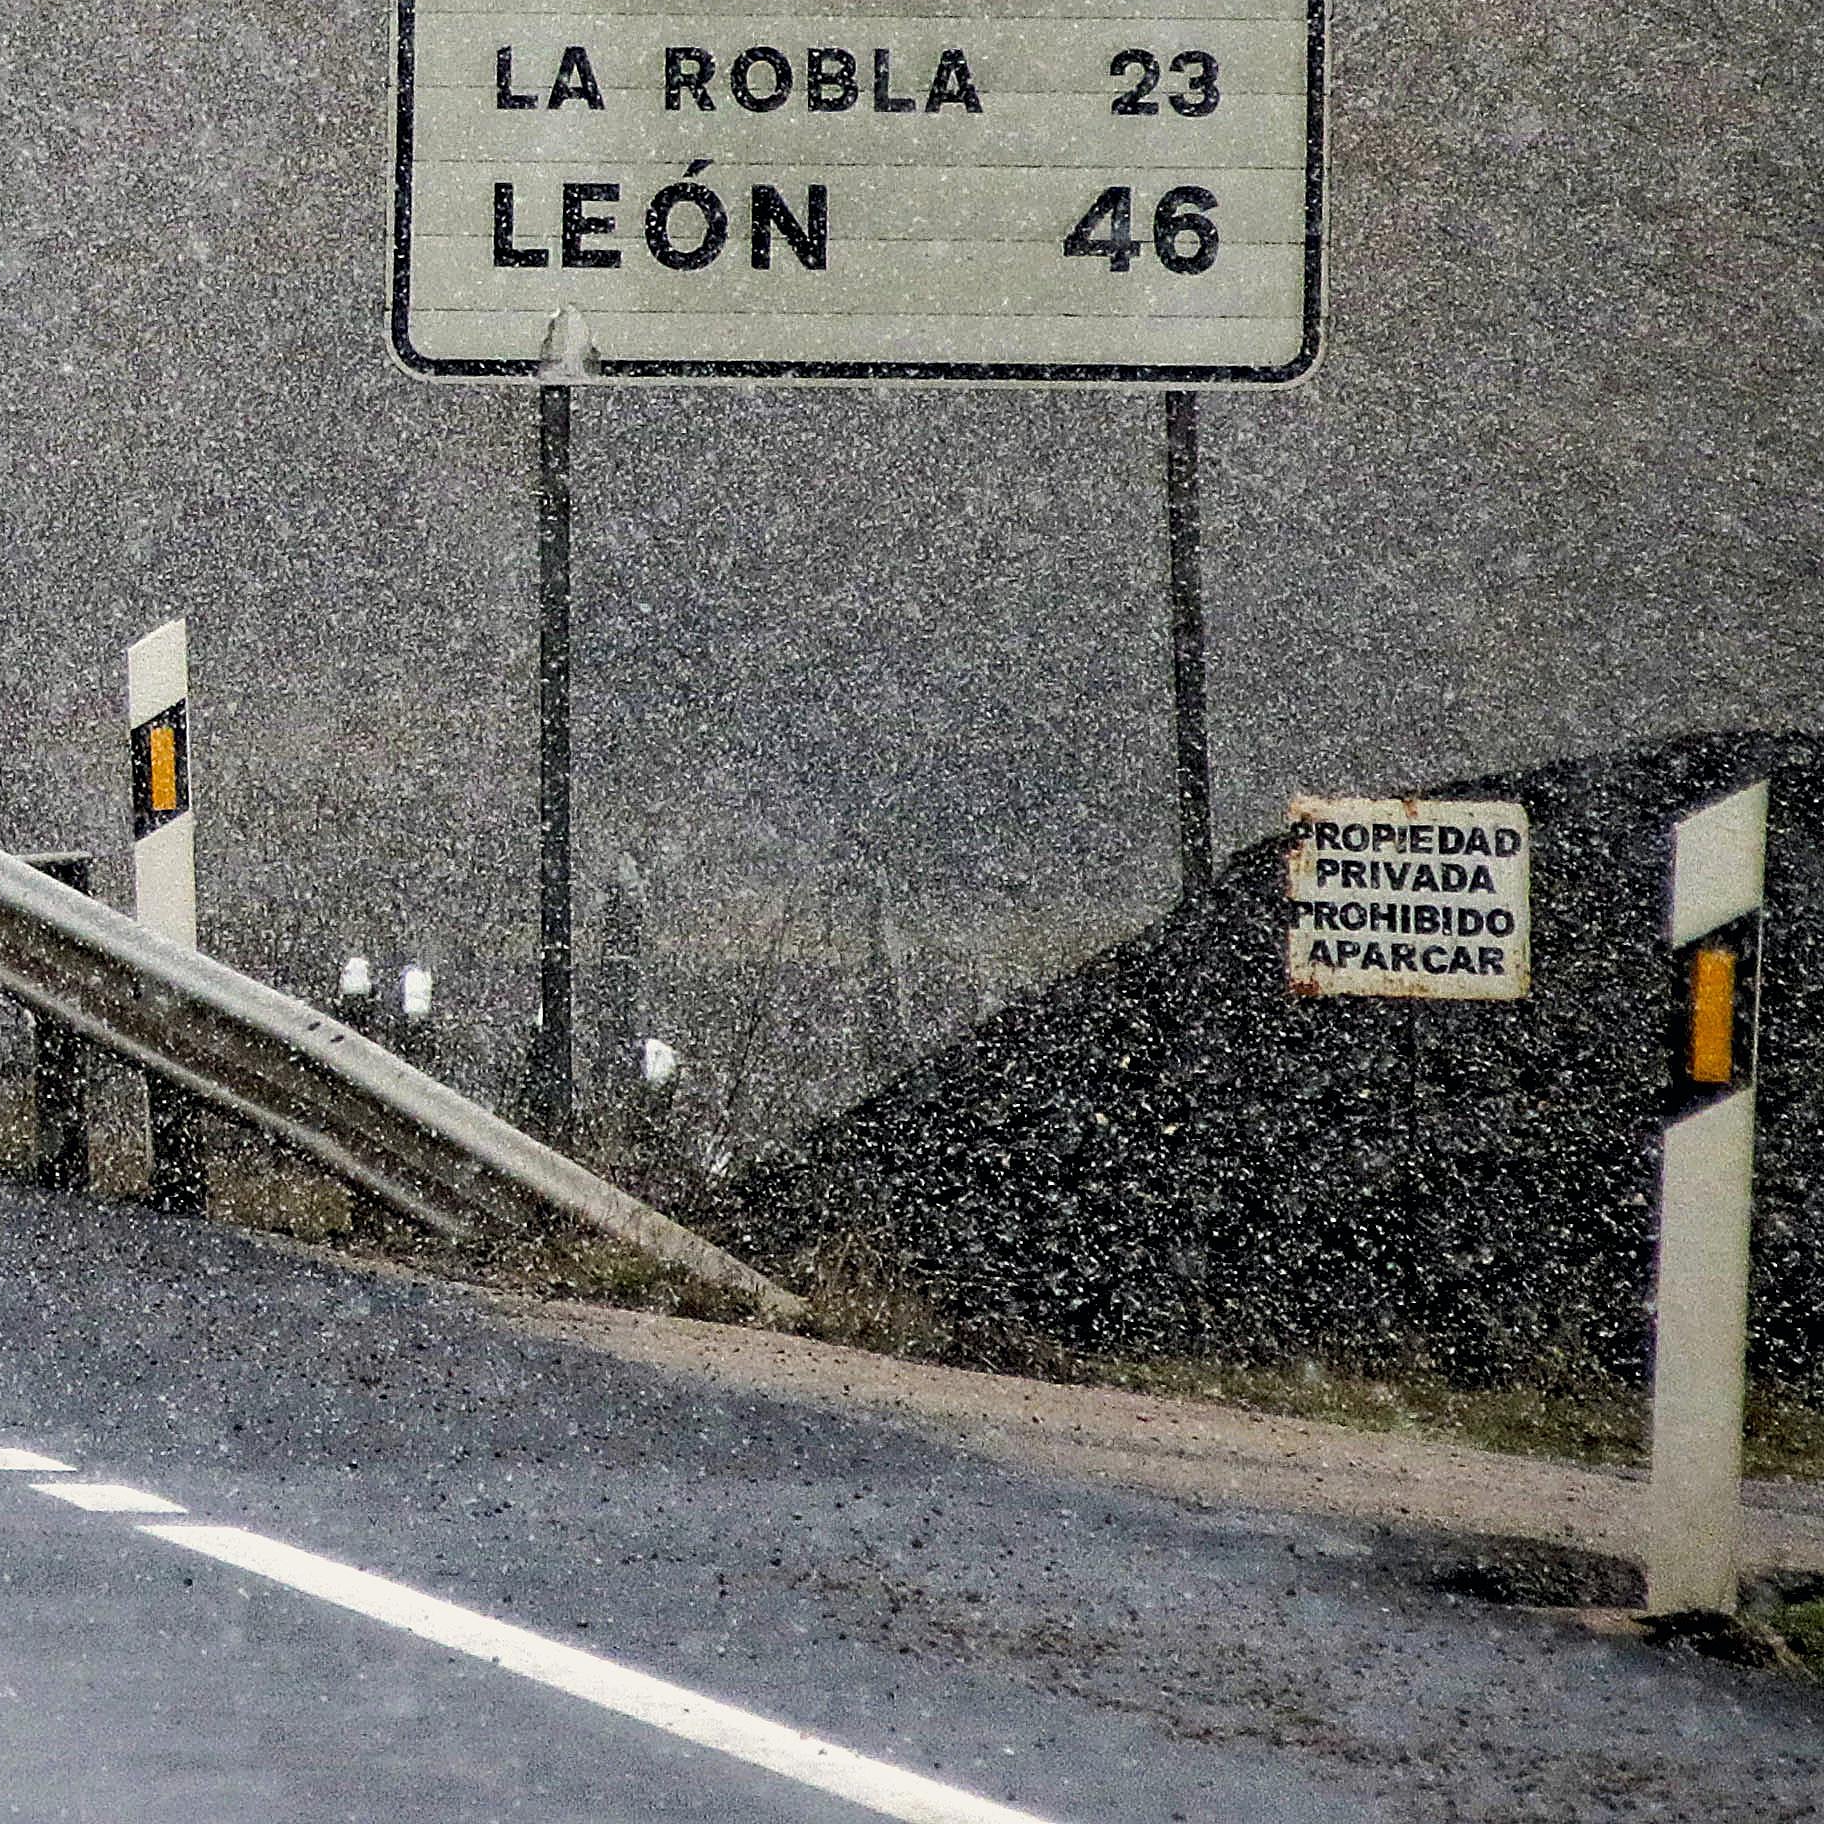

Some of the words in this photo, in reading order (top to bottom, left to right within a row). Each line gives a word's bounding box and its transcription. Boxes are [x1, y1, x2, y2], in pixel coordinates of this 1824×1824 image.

[495, 46, 605, 110] LA
[664, 46, 984, 115] ROBLA
[1108, 48, 1220, 117] 23
[493, 158, 829, 271] LEÓN
[1062, 185, 1220, 274] 46
[1290, 821, 1522, 858] PROPIEDAD
[1315, 858, 1497, 894] PRIVADA
[1292, 900, 1515, 938] PROHIBIDO
[1308, 939, 1505, 975] APARCAR
